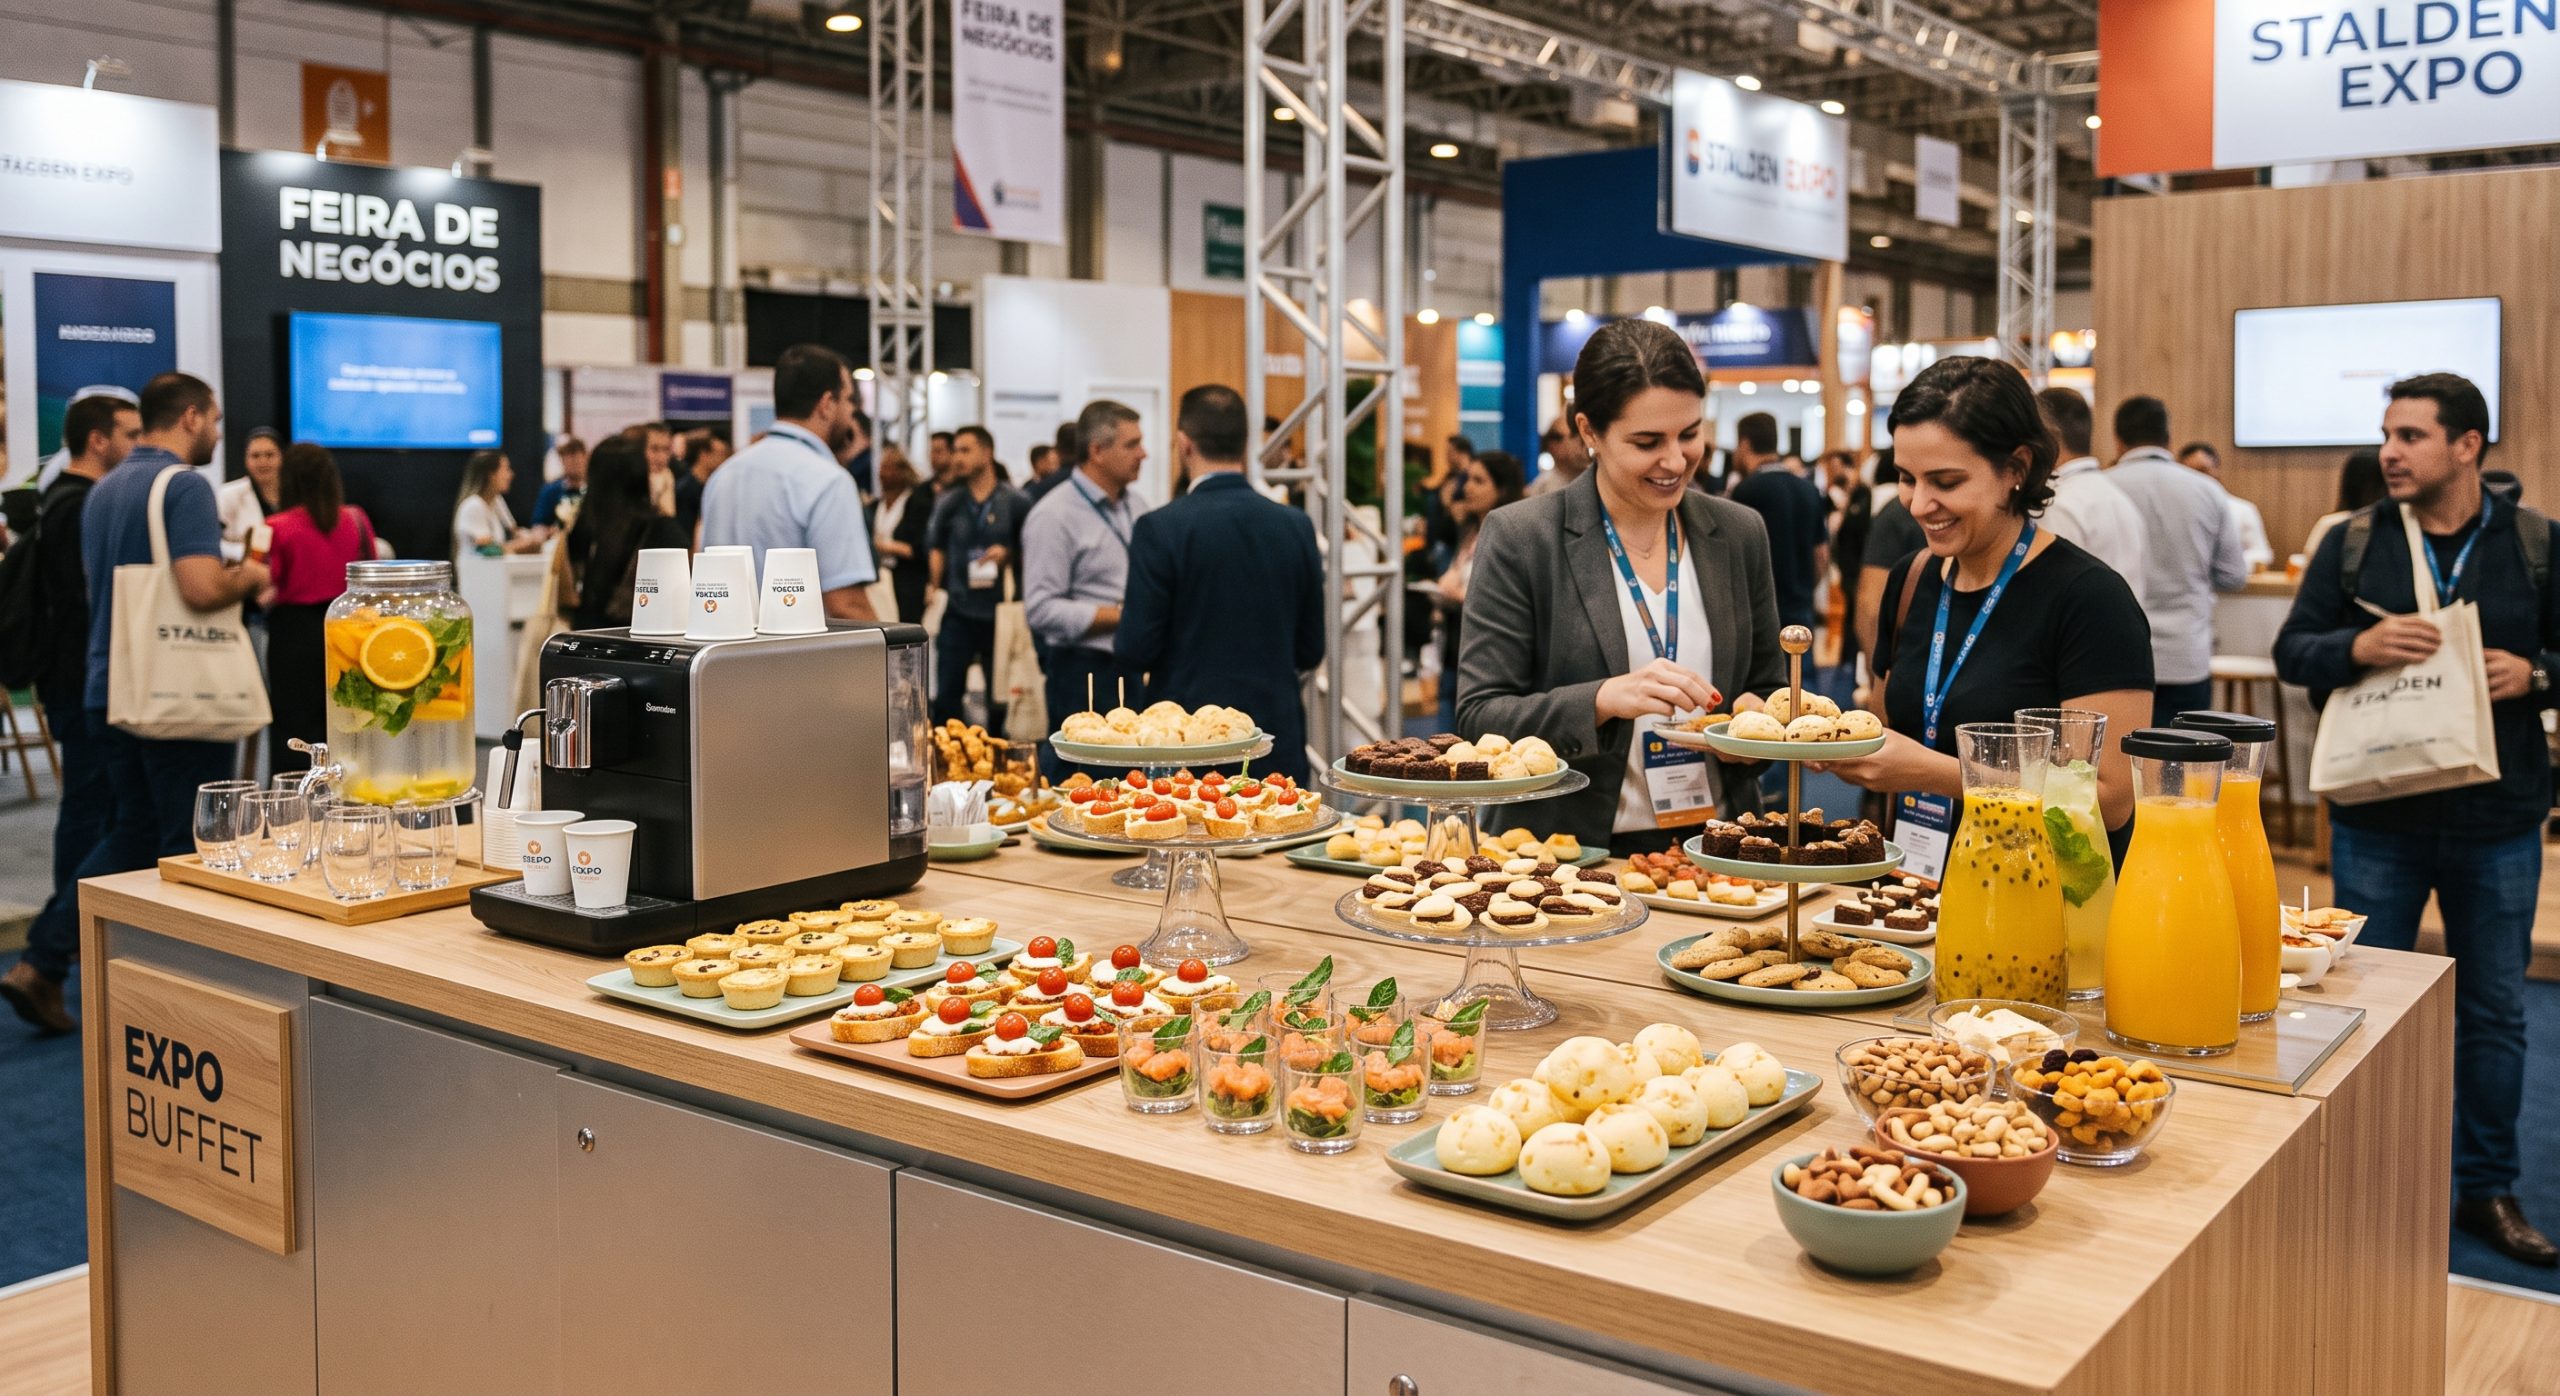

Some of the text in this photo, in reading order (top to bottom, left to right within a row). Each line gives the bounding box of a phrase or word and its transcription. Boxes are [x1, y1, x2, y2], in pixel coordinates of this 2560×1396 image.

[1026, 11, 1052, 39] DE
[2251, 0, 2557, 62] STALDEN
[2340, 50, 2522, 109] EXPO
[1707, 141, 1779, 185] STALDEN
[1785, 157, 1838, 201] EXPO
[279, 186, 500, 248] FEIRA DE
[279, 239, 501, 293] NEGÓCIOS
[125, 1024, 224, 1103] EXPO
[127, 1086, 262, 1184] BUFFET
